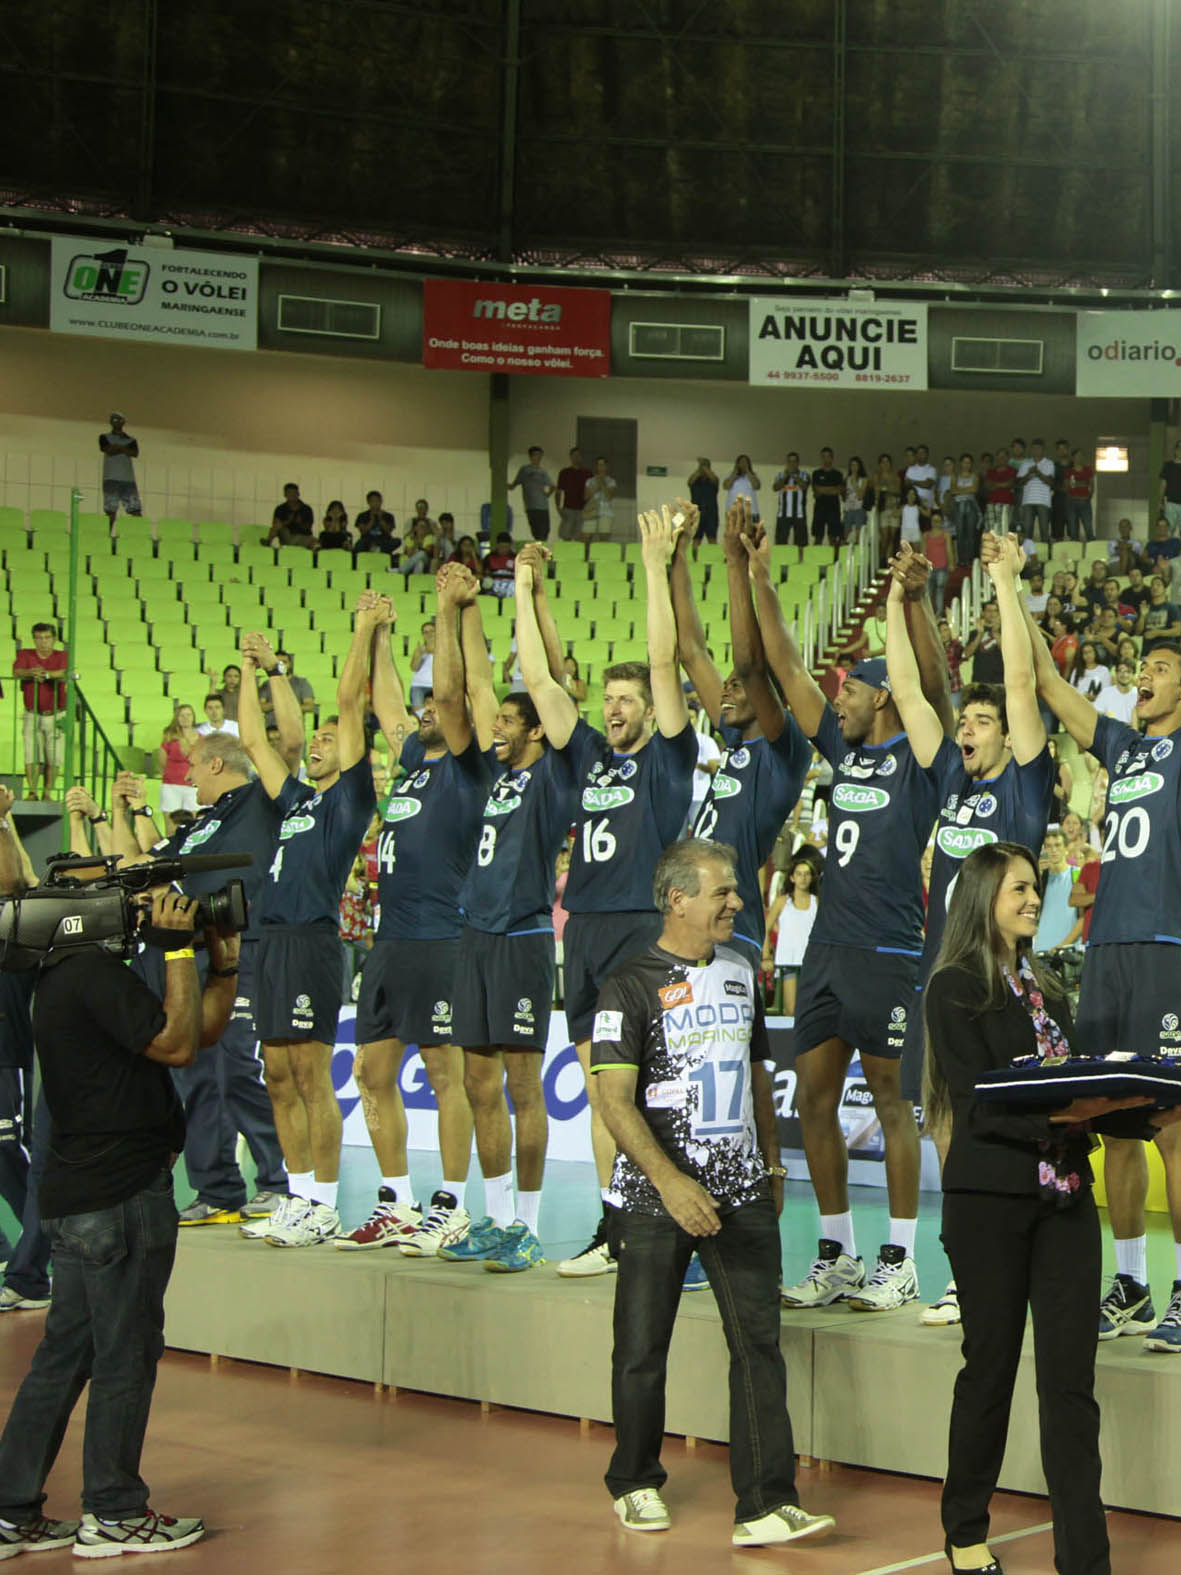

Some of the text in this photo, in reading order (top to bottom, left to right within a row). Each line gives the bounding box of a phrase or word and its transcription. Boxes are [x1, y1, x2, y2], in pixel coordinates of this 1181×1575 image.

[73, 265, 141, 295] ONE
[161, 264, 247, 279] FORTALECENDO
[162, 280, 247, 300] O VÔLEI
[161, 302, 247, 317] MARINGAENSE
[473, 298, 562, 322] meta
[758, 315, 918, 344] ANUNCIE
[429, 338, 459, 349] Onde
[462, 340, 489, 350] boas
[492, 342, 524, 353] ideias
[527, 345, 571, 356] ganham
[795, 345, 881, 371] AQUI
[461, 353, 494, 365] Como
[507, 358, 541, 367] nosso
[387, 801, 411, 815] ADA
[835, 787, 878, 805] SADA
[478, 825, 497, 867] 8
[583, 817, 616, 863] 16
[835, 820, 860, 867] 9
[1101, 806, 1150, 864] 20
[378, 831, 396, 874] 14
[64, 918, 81, 932] 07
[689, 1060, 744, 1122] 17
